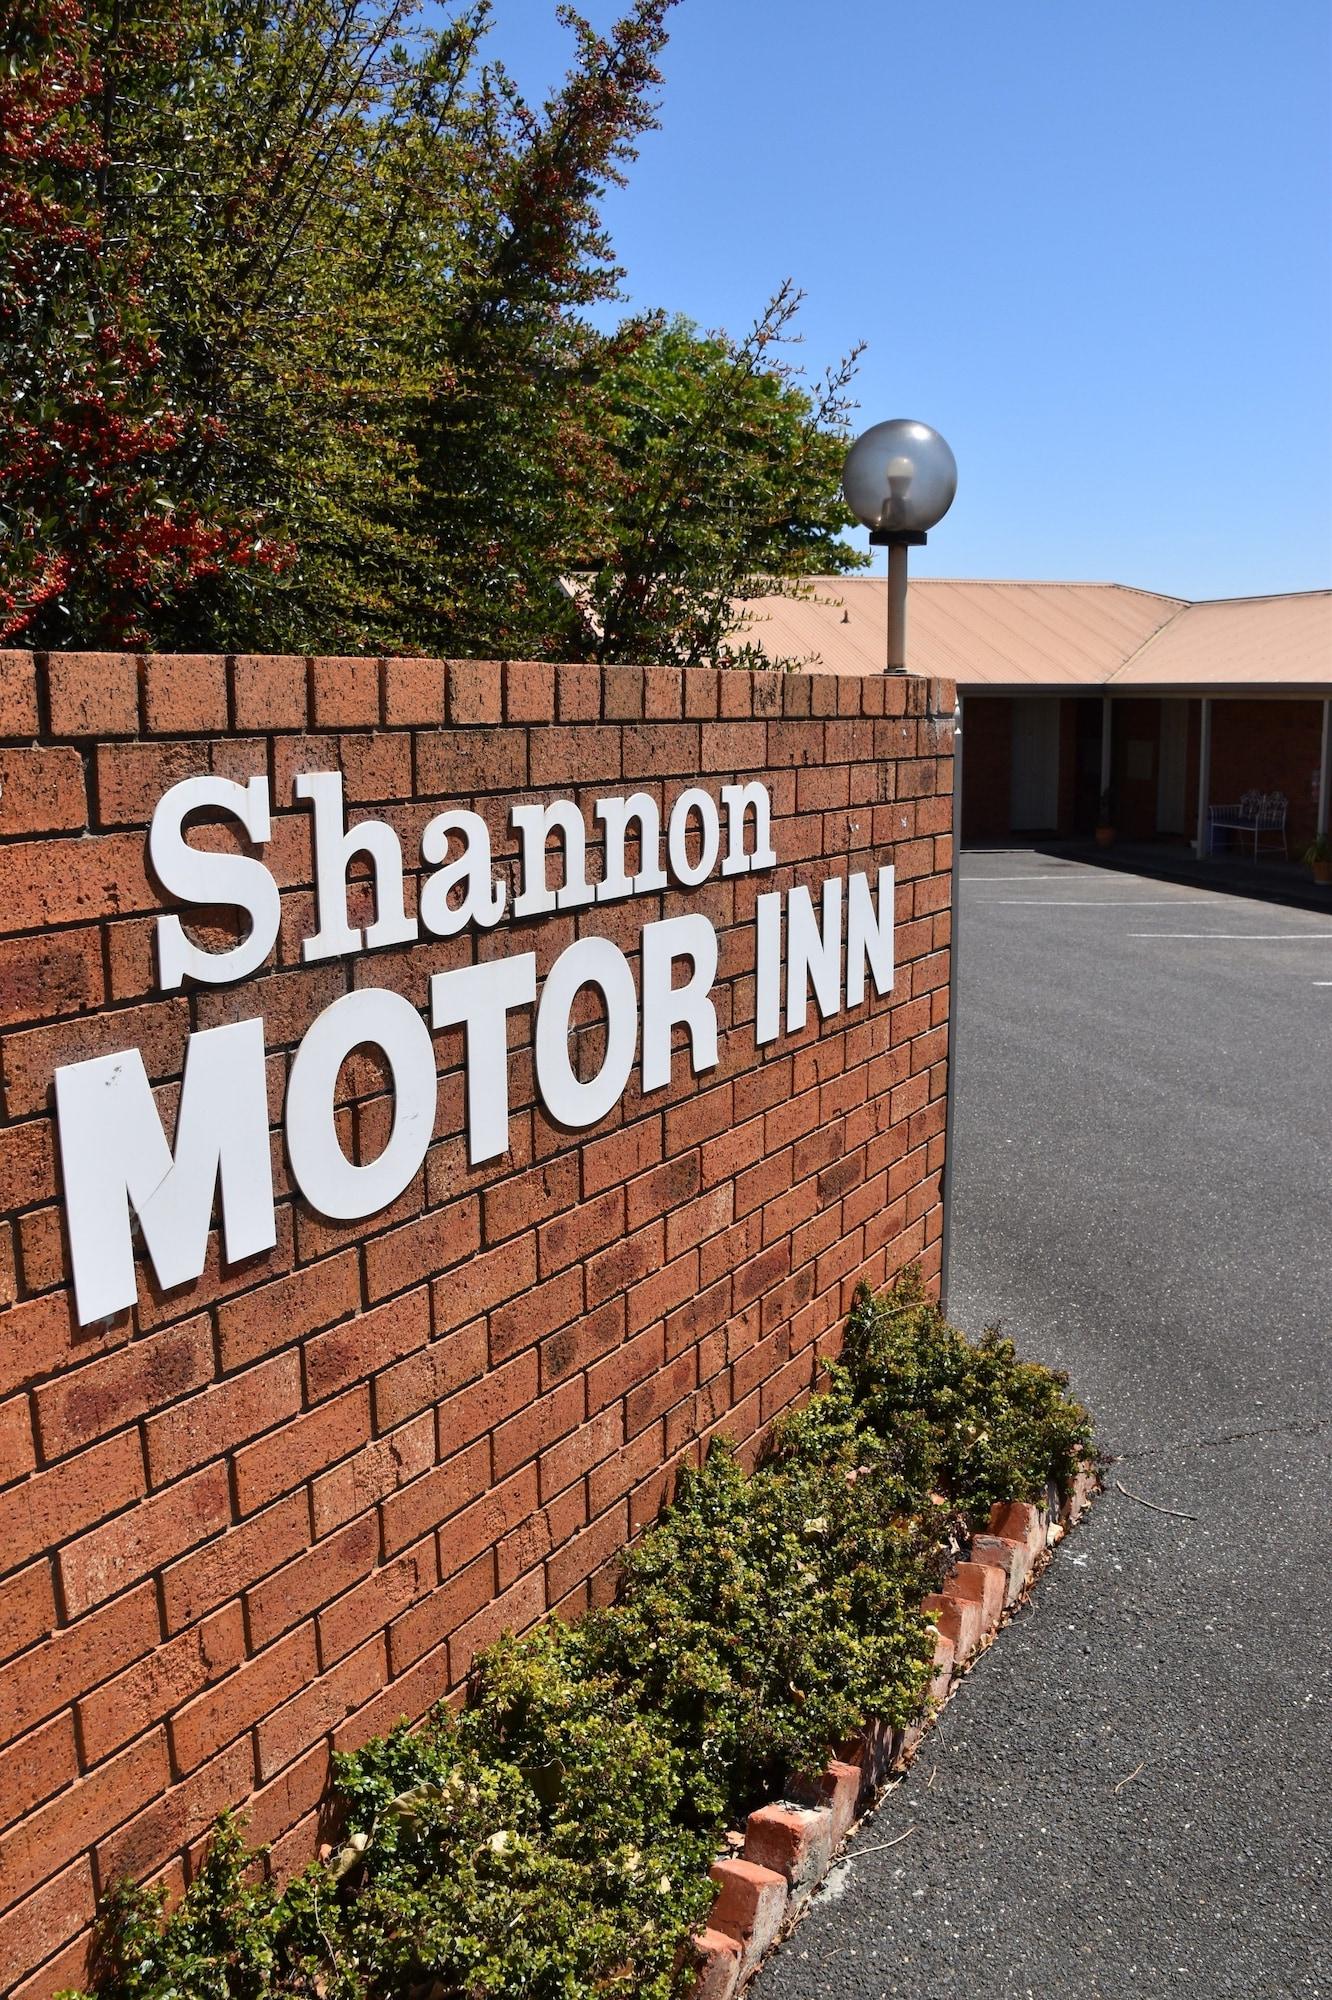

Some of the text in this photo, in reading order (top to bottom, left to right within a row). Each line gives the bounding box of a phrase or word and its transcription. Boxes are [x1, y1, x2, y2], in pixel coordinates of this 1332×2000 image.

[150, 770, 777, 991] Shannon
[54, 865, 895, 1327] MOTOR INN
